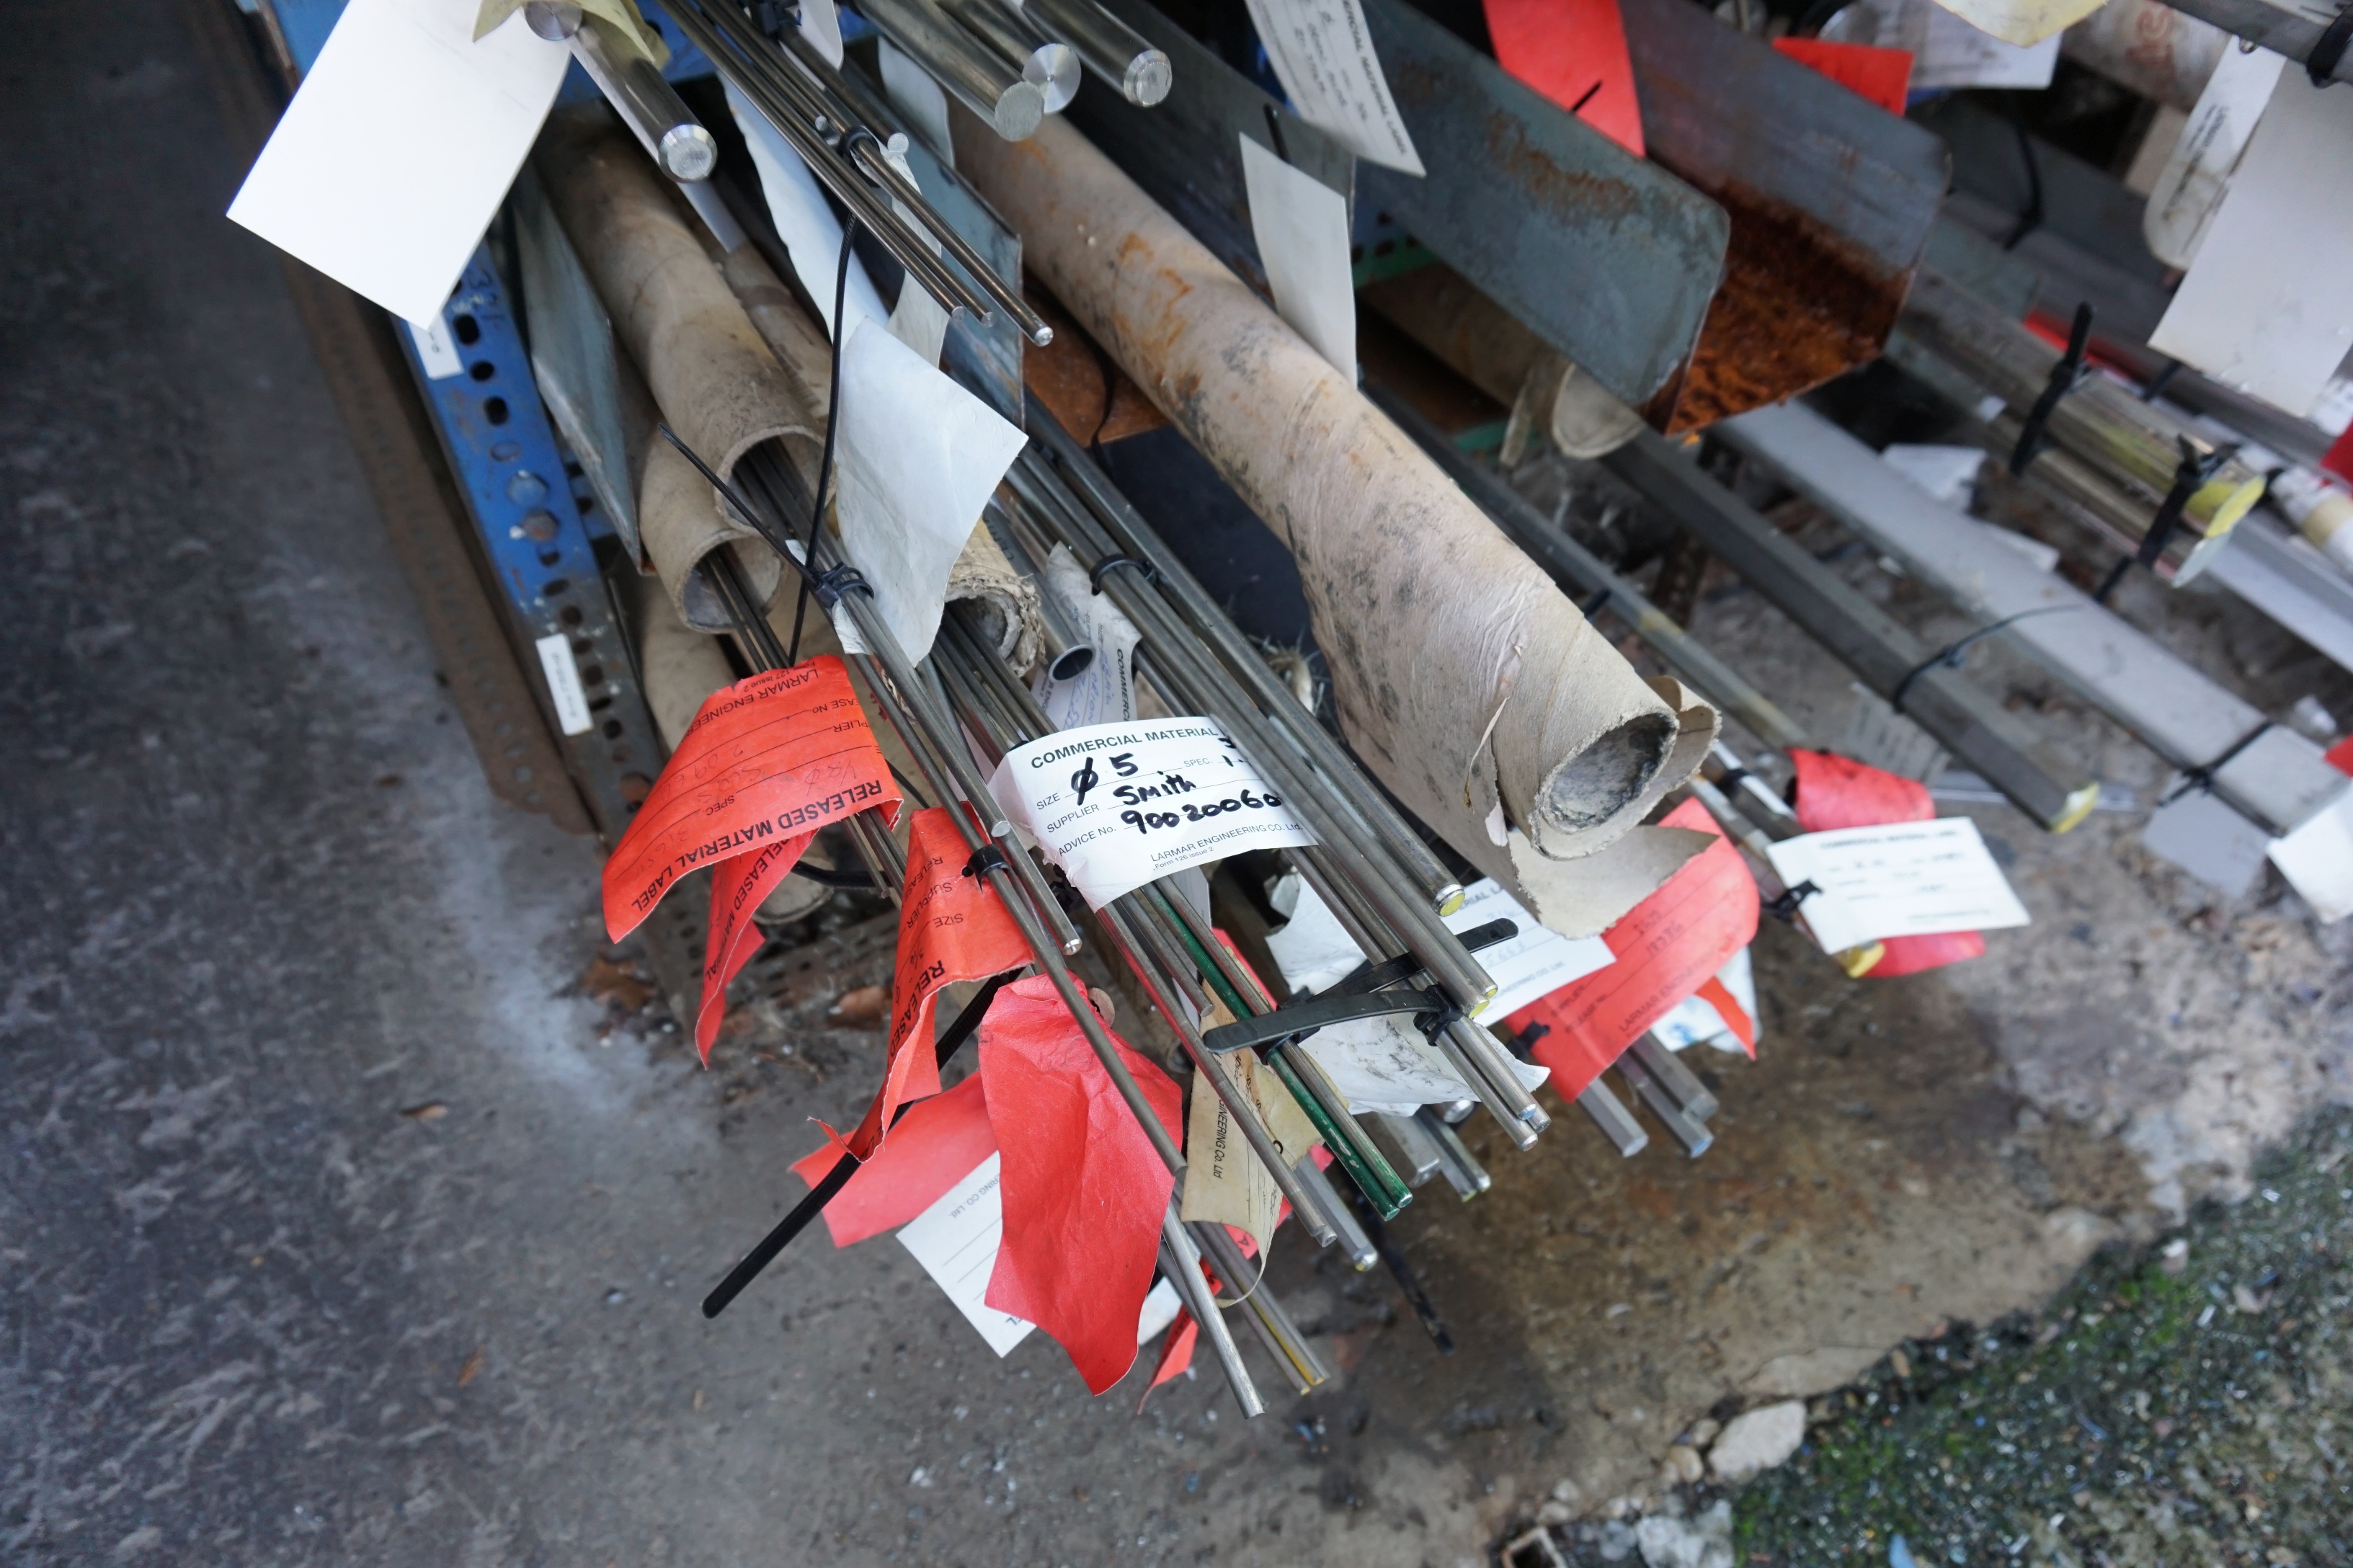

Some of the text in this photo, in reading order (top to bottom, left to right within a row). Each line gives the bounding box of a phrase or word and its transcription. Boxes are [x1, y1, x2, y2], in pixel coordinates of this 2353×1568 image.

[752, 675, 773, 688] issue
[759, 669, 819, 700] LARMAR
[776, 669, 790, 680] 127
[1031, 727, 1219, 769] COMMERCIAL MATERIAL
[1108, 752, 1139, 777] 5
[1183, 757, 1213, 768] SPEC.
[702, 795, 735, 816] SPEC.
[1036, 793, 1061, 811] SIZE
[1047, 803, 1100, 833] SUPPLIER
[631, 780, 882, 912] RELEASED MATERIAL LABEL
[1058, 826, 1116, 857] ADVICE No.
[1150, 822, 1303, 862] LARMAR ENGINEERING CO. Ltd.
[1155, 859, 1174, 870] Form
[1174, 854, 1188, 863] 126
[1188, 848, 1208, 858] issue
[907, 881, 953, 929] SUPPLIER
[933, 913, 964, 928] SIZE
[891, 960, 945, 1058] RELEASED
[1213, 1165, 1224, 1180] Ltd
